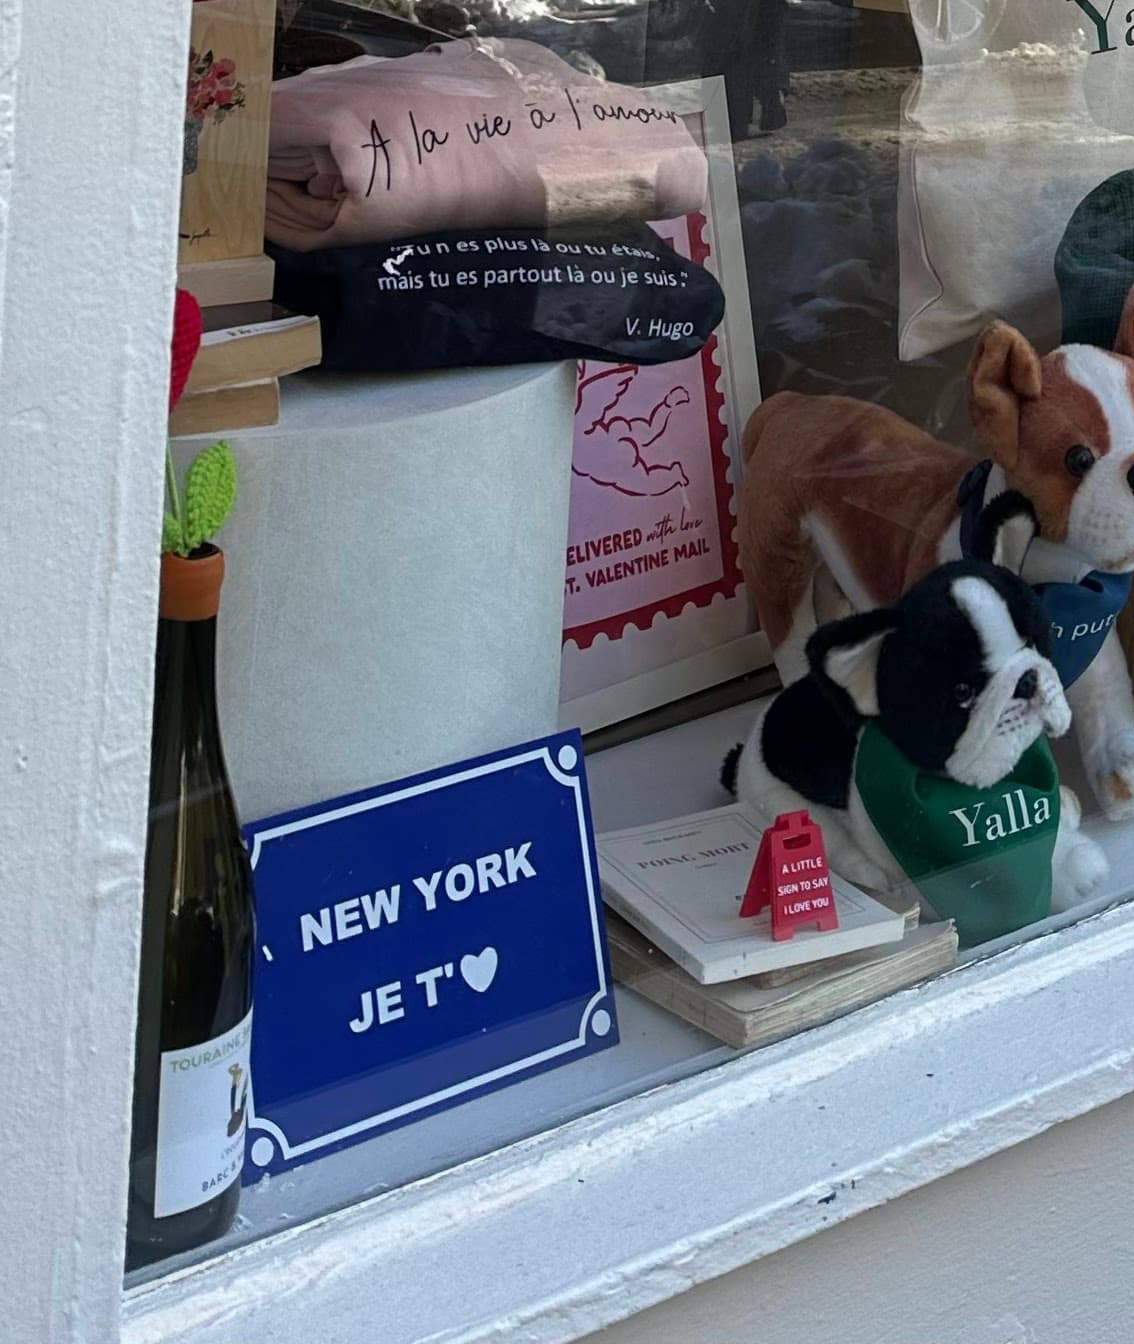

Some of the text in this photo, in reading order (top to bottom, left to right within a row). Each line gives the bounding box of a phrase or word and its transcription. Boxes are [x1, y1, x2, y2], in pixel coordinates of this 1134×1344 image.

[408, 110, 449, 165] la
[466, 112, 512, 145] vie
[484, 237, 528, 254] plus
[583, 244, 607, 256] tu
[377, 270, 425, 291] mais
[428, 269, 450, 288] tu
[456, 269, 479, 286] es
[484, 266, 563, 289] partout
[566, 264, 585, 284] là
[590, 270, 616, 284] ou
[620, 266, 640, 289] je
[625, 316, 695, 342] V. Hugo
[566, 528, 643, 567] ELIVERED
[585, 548, 670, 588] VALENTINE
[673, 537, 710, 563] MAIL
[948, 788, 1051, 848] Yalla
[782, 856, 823, 875] A LITTLE
[300, 841, 537, 953] NEW YORK
[777, 876, 829, 897] SIGN TO SAY
[788, 899, 811, 915] LOVE
[811, 896, 829, 909] YOU
[348, 981, 405, 1034] JE
